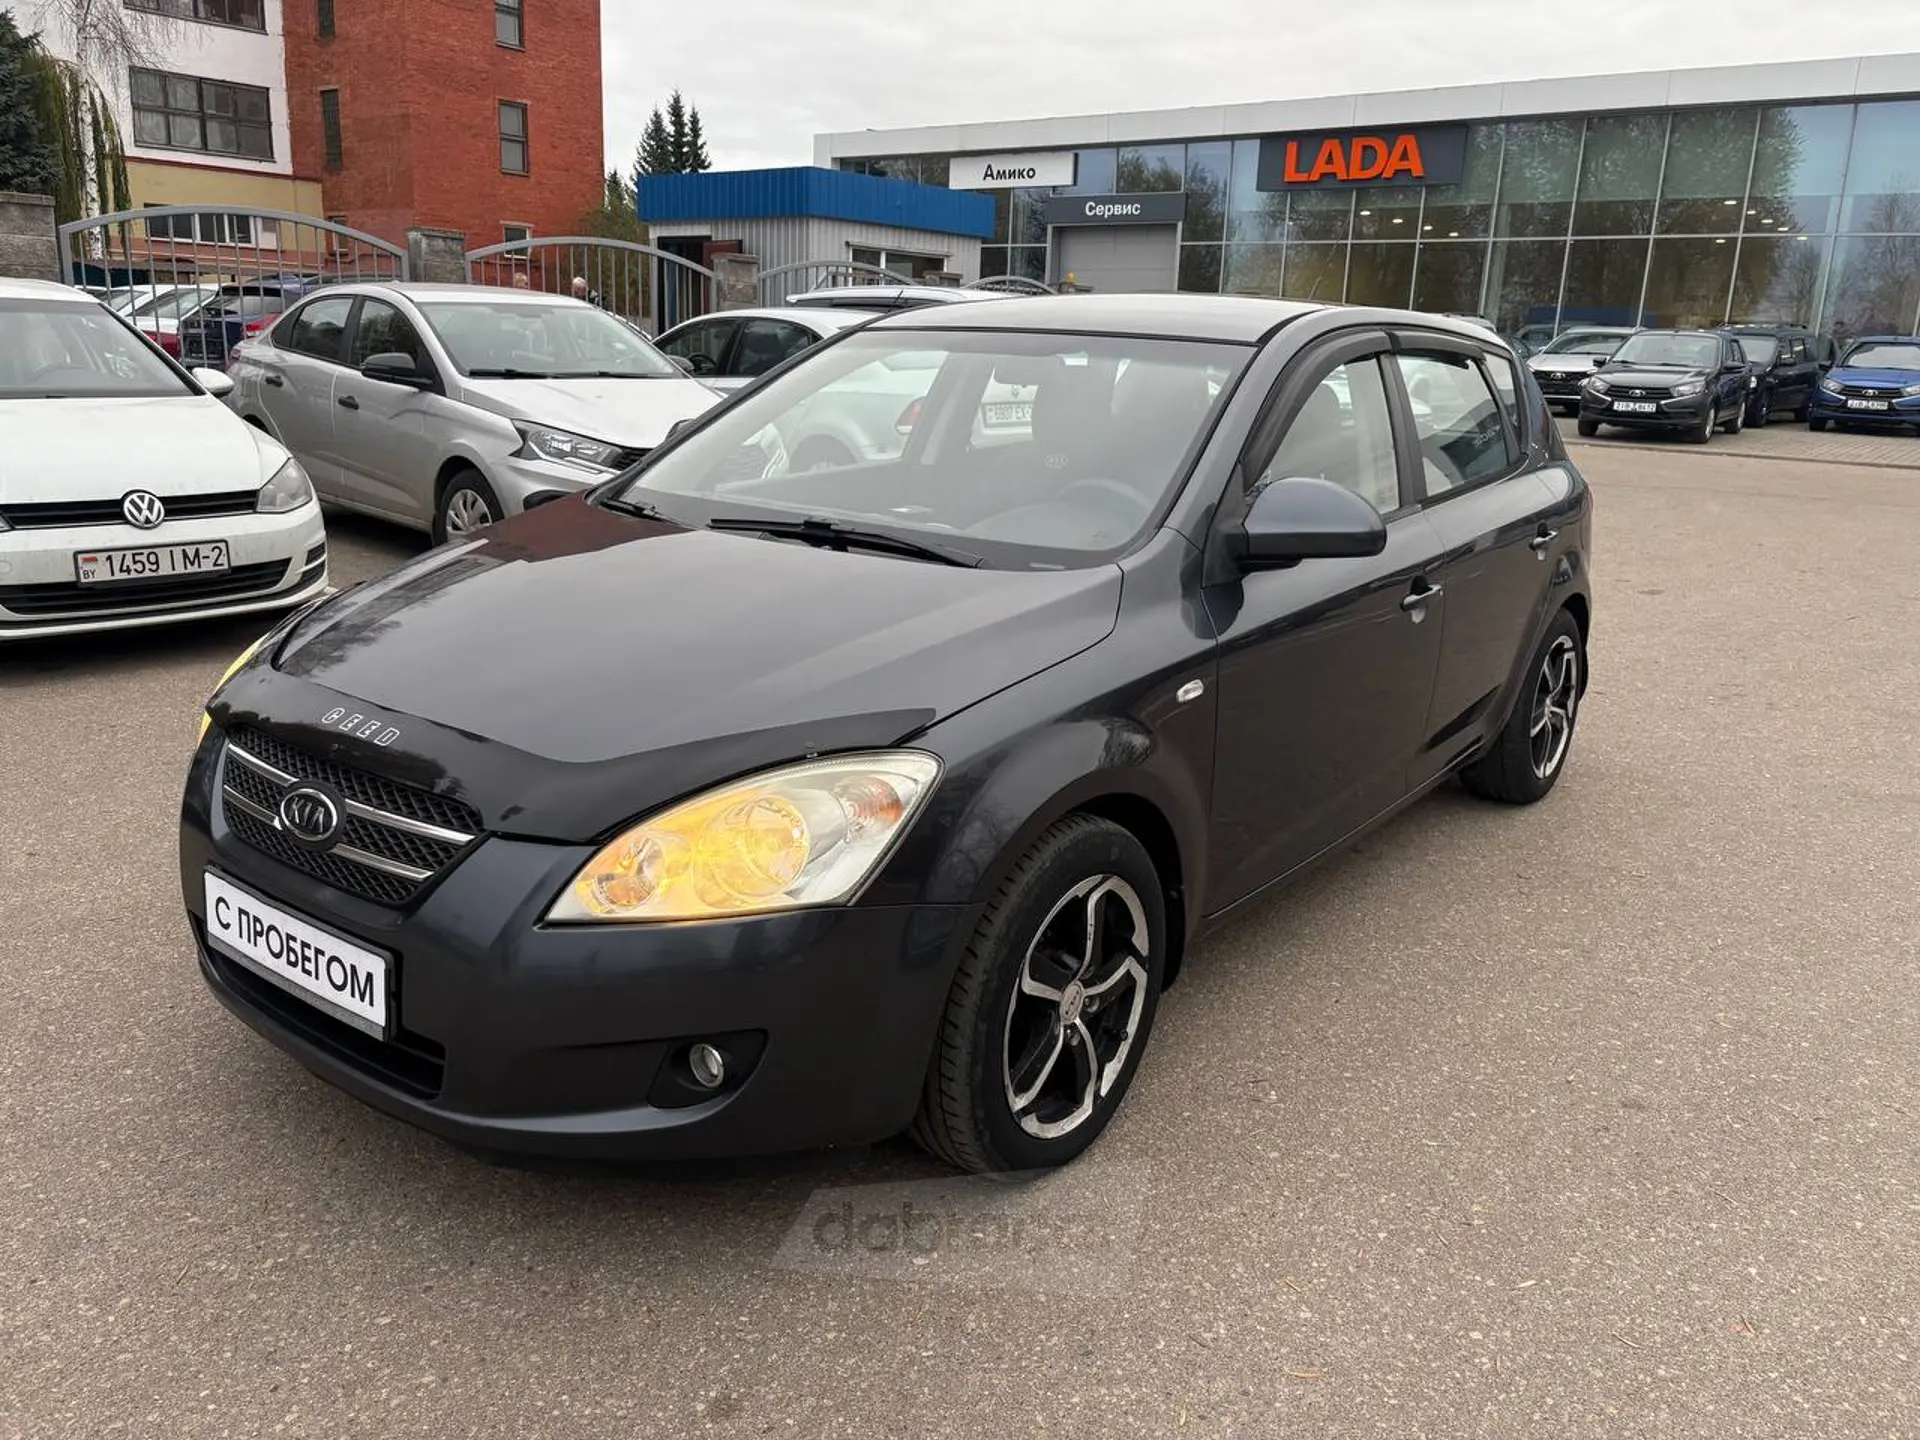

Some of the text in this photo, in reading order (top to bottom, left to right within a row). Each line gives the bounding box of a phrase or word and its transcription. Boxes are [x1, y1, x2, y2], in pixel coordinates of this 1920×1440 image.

[1283, 134, 1425, 182] LADA
[983, 164, 1036, 181] Амико
[1085, 202, 1141, 218] Сервис
[83, 569, 96, 580] BY
[106, 551, 160, 577] 1459
[215, 896, 375, 1008] С ПРОБЕГОМ
